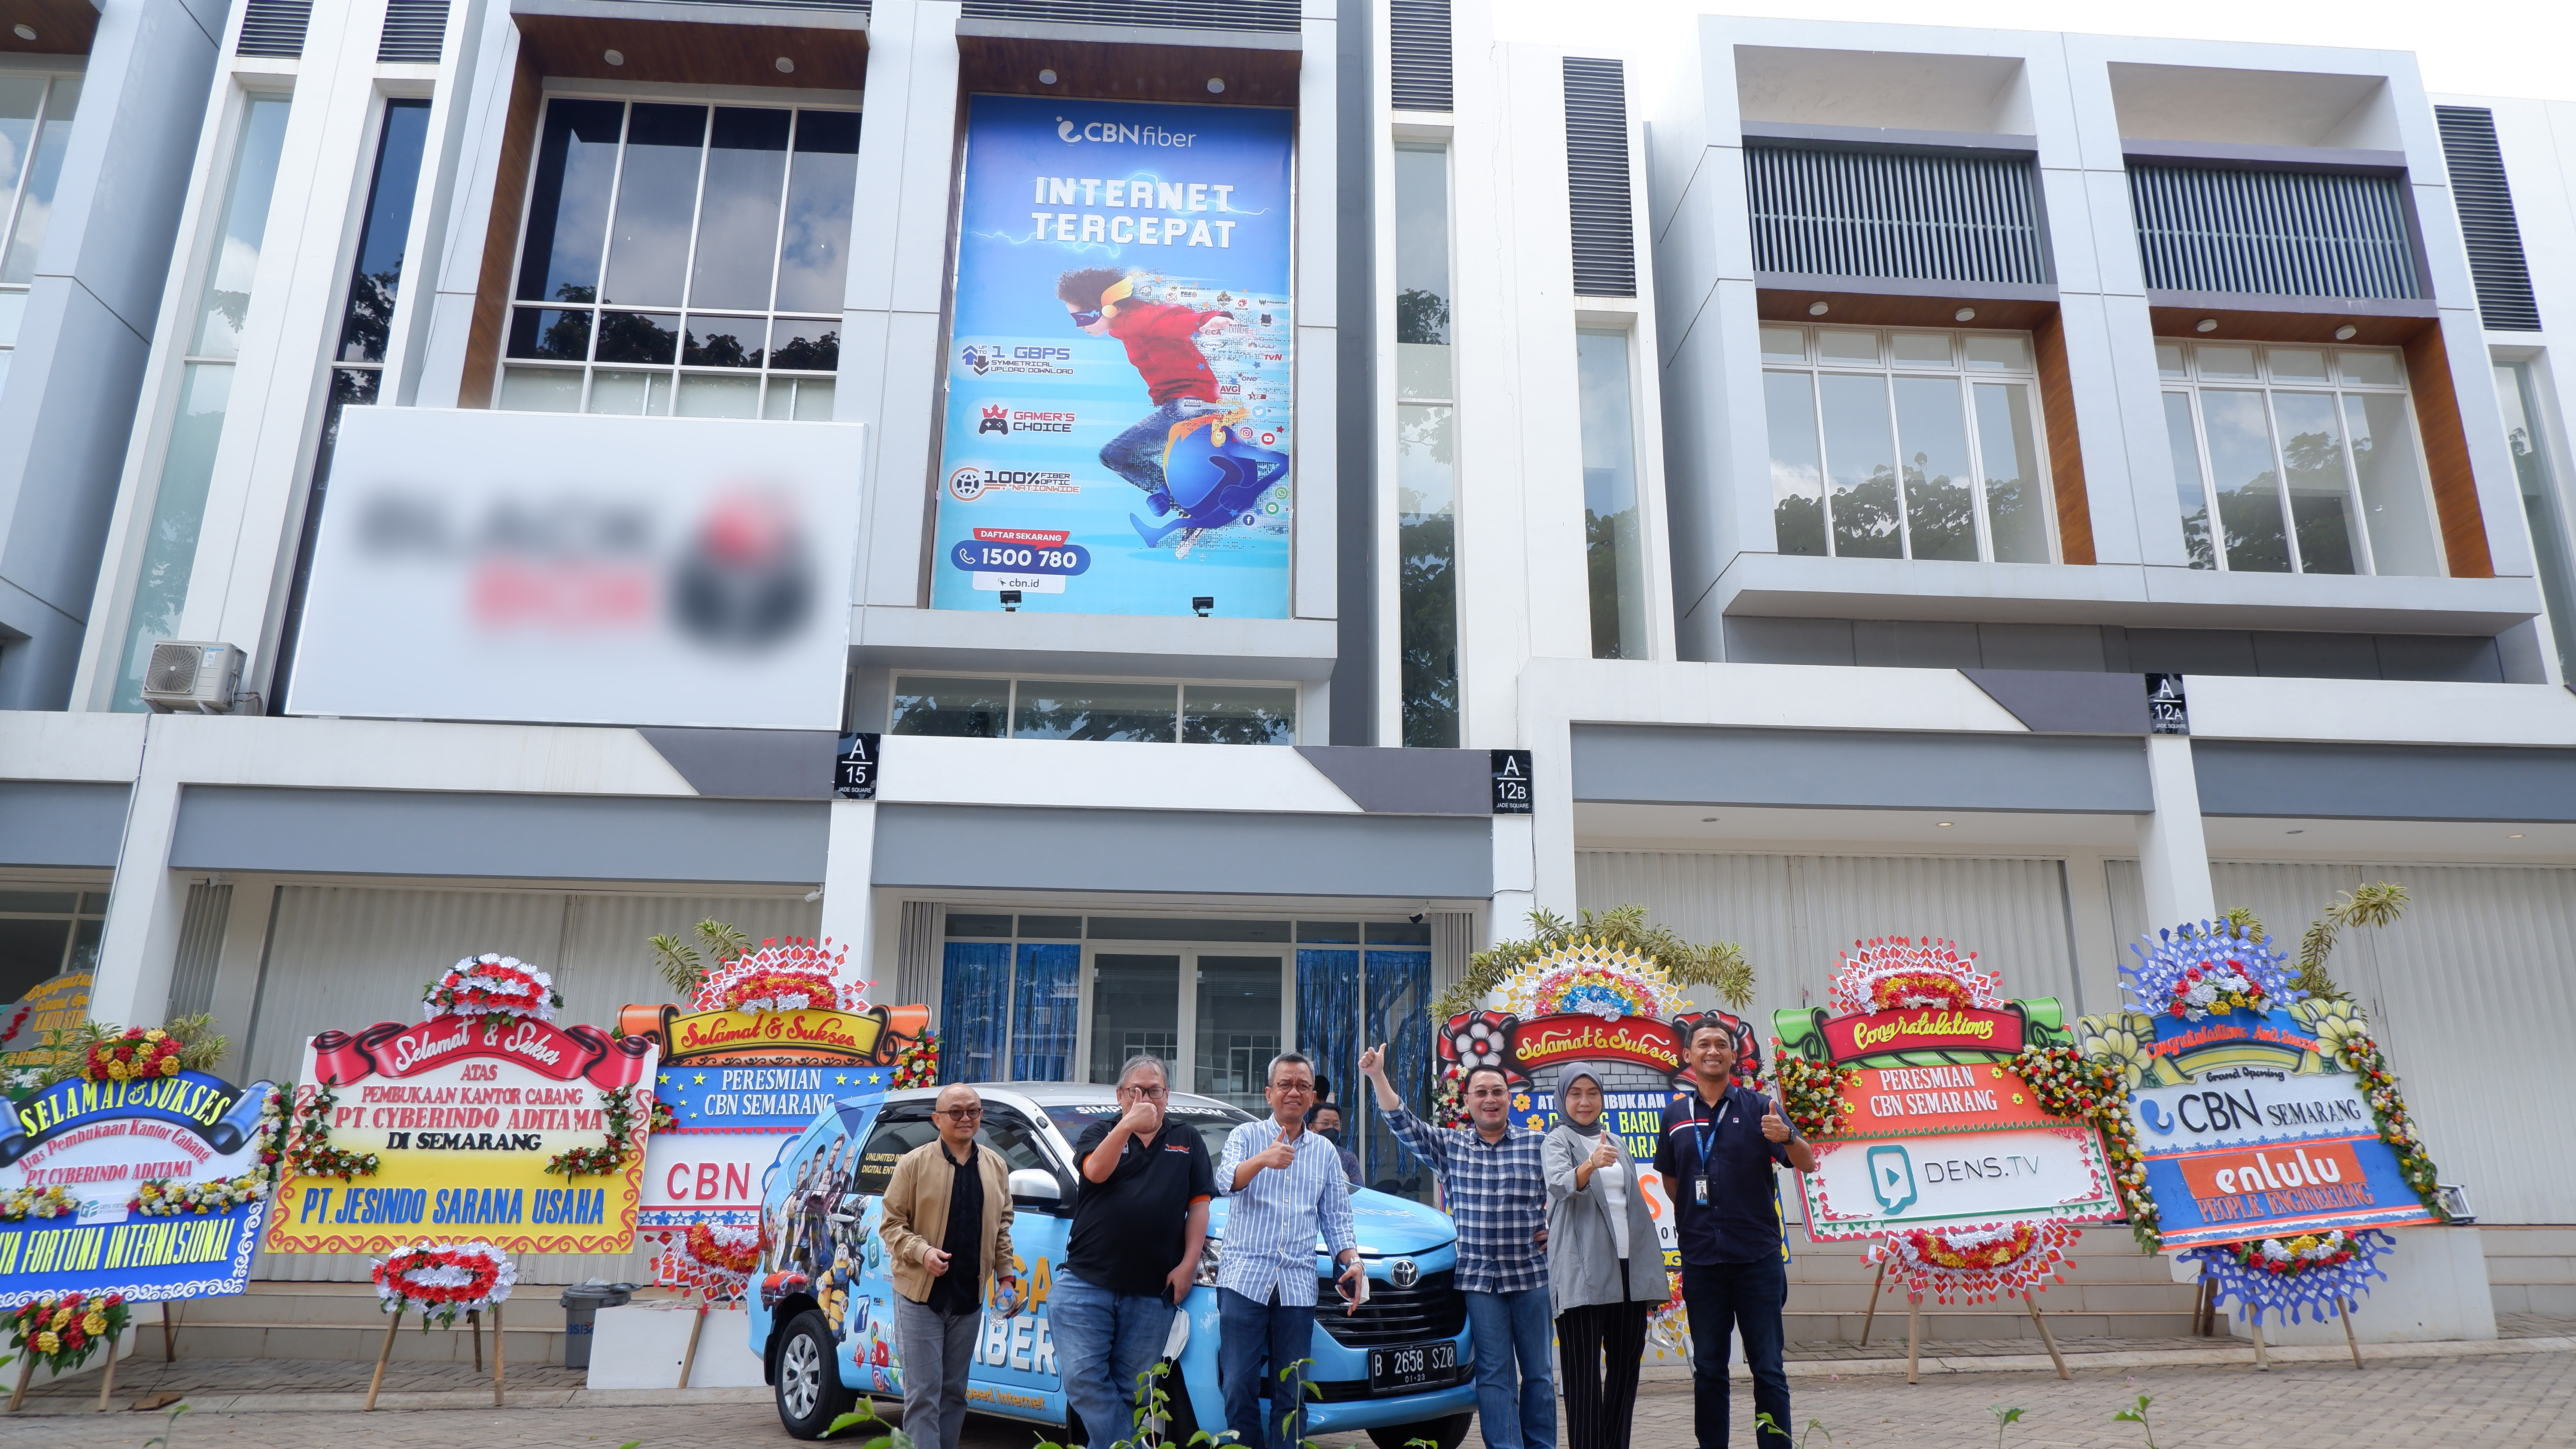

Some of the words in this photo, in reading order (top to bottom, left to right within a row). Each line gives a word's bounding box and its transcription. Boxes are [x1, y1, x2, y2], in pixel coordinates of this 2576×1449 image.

[1035, 176, 1234, 212] INTERNET
[1032, 212, 1236, 248] TERCEPAT
[992, 346, 1005, 358] 1
[1014, 346, 1070, 360] GBPS
[1013, 422, 1072, 432] CHOICE
[1014, 411, 1075, 422] GAMER'S
[984, 470, 1040, 485] 100%
[1012, 485, 1080, 493] NATIONWIDE
[981, 530, 1014, 539] DAFTAR
[1016, 532, 1062, 542] SEKARANG
[982, 548, 1032, 566] 1500
[1038, 551, 1077, 568] 780
[1009, 579, 1039, 588] cbn.id
[2160, 679, 2175, 698] A
[2155, 704, 2183, 720] 12A
[849, 739, 866, 760] A
[847, 766, 866, 784] 15
[1504, 755, 1519, 776] A
[1498, 782, 1526, 799] 12B
[681, 1014, 764, 1048] Selamat
[765, 1017, 784, 1039] &
[786, 1015, 857, 1046] Sukses
[1854, 1011, 1994, 1051] Congratulations
[2145, 1024, 2249, 1060] Congratulations
[2252, 1025, 2281, 1043] And
[396, 1016, 477, 1071] Selamat
[484, 1023, 498, 1046] &
[504, 1022, 560, 1066] Sukses
[1516, 1026, 1593, 1061] Selamat
[1593, 1028, 1609, 1049] &
[1609, 1028, 1680, 1068] Sukses
[460, 1064, 498, 1081] ATAS
[722, 1069, 822, 1091] PERESMIAN
[1879, 1066, 1975, 1091] PERESMIAN
[2206, 1068, 2242, 1082] Grand
[2242, 1067, 2285, 1082] Opening
[361, 1085, 456, 1103] PEMBUKAAN
[460, 1087, 521, 1104] KANTOR
[525, 1088, 583, 1105] CABANG
[705, 1094, 739, 1116] CBN
[1870, 1094, 1904, 1117] CBN
[1905, 1089, 1998, 1116] SEMARANG
[20, 1078, 130, 1138] SELAMAT
[128, 1082, 147, 1105] &
[144, 1078, 231, 1126] SUKSES
[2178, 1088, 2263, 1133] CBN
[2266, 1098, 2361, 1126] SEMARANG
[505, 1108, 603, 1132] ADITAMA
[1619, 1111, 1660, 1133] BARU
[18, 1149, 46, 1173] Atas
[46, 1122, 127, 1156] Pembukaan
[128, 1119, 173, 1140] Kantor
[171, 1128, 213, 1164] Cabang
[386, 1132, 411, 1150] DI
[416, 1133, 543, 1151] SEMARANG
[866, 1153, 895, 1162] UNLIMITED
[25, 1169, 47, 1186] PT
[48, 1164, 128, 1185] CYBERINDO
[131, 1160, 193, 1180] ADITAMA
[861, 1165, 882, 1174] DIGITAL
[1924, 1155, 2038, 1183] DENS.TV
[2216, 1149, 2341, 1194] enlulu
[667, 1162, 750, 1200] CBN
[431, 1188, 523, 1225] SARANA
[531, 1188, 605, 1225] USAHA
[2195, 1194, 2265, 1222] PEOPLE
[2265, 1183, 2374, 1215] ENGINEERING
[20, 1227, 105, 1274] FORTUNA
[104, 1218, 236, 1270] INTERNASIONAL
[1375, 1354, 1382, 1376] B
[1394, 1349, 1424, 1373] 2658
[996, 1387, 1046, 1411] Internet
